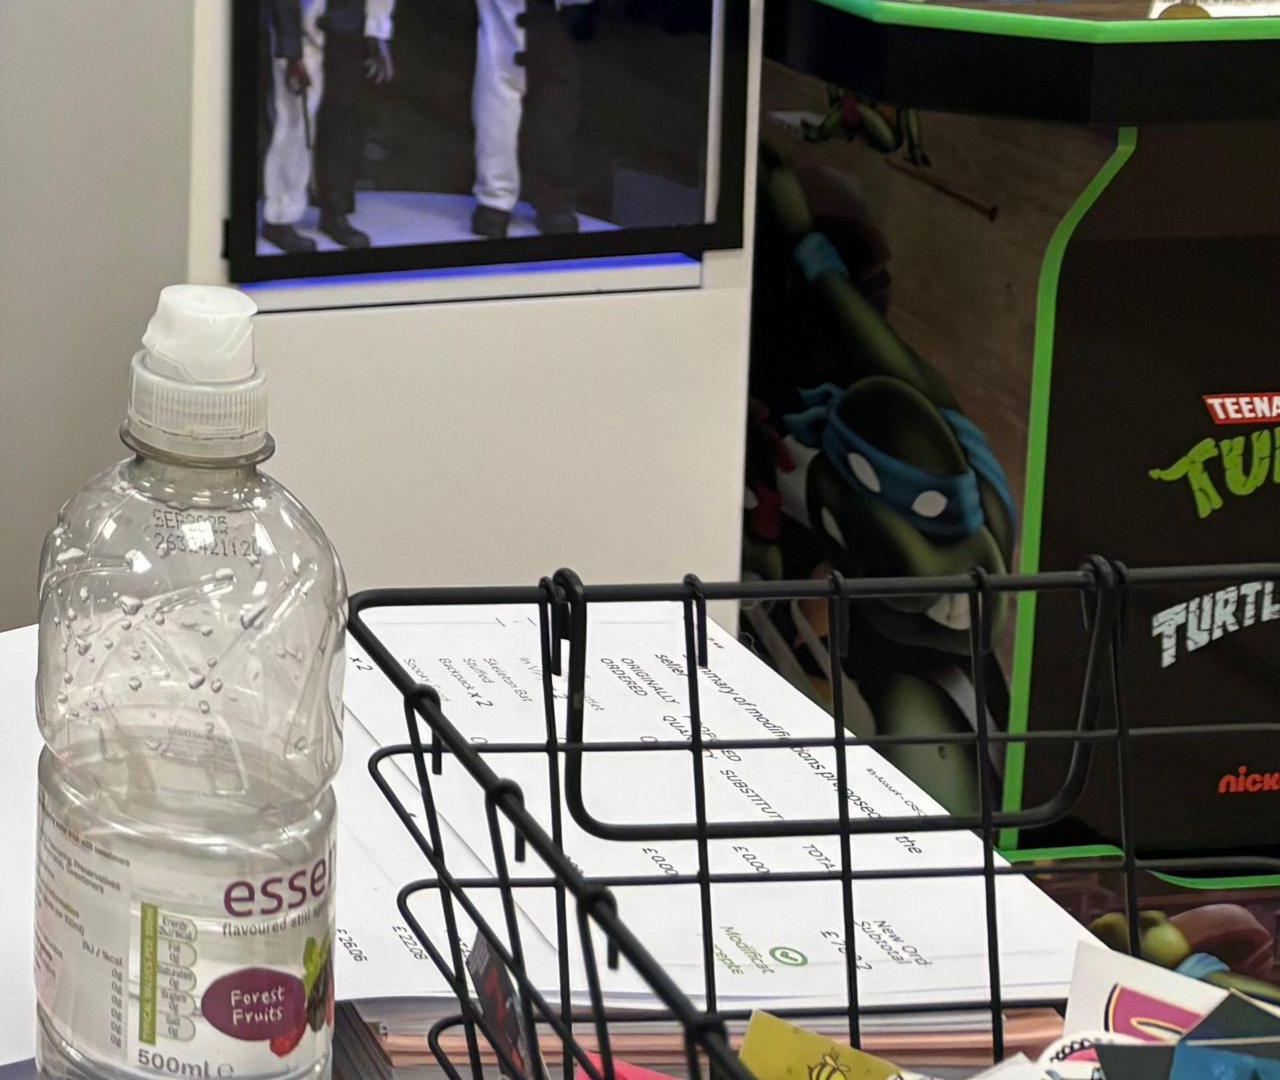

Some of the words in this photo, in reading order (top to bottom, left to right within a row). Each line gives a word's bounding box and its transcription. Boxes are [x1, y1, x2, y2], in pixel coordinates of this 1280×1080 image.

[361, 663, 374, 672] 2
[600, 657, 649, 697] ORDERED
[478, 696, 493, 708] 2
[895, 835, 923, 854] the
[222, 920, 287, 938] flavoured
[873, 920, 904, 945] New
[231, 986, 285, 1006] Forest
[232, 1007, 284, 1026] Fruits
[137, 1048, 209, 1078] 500ml
